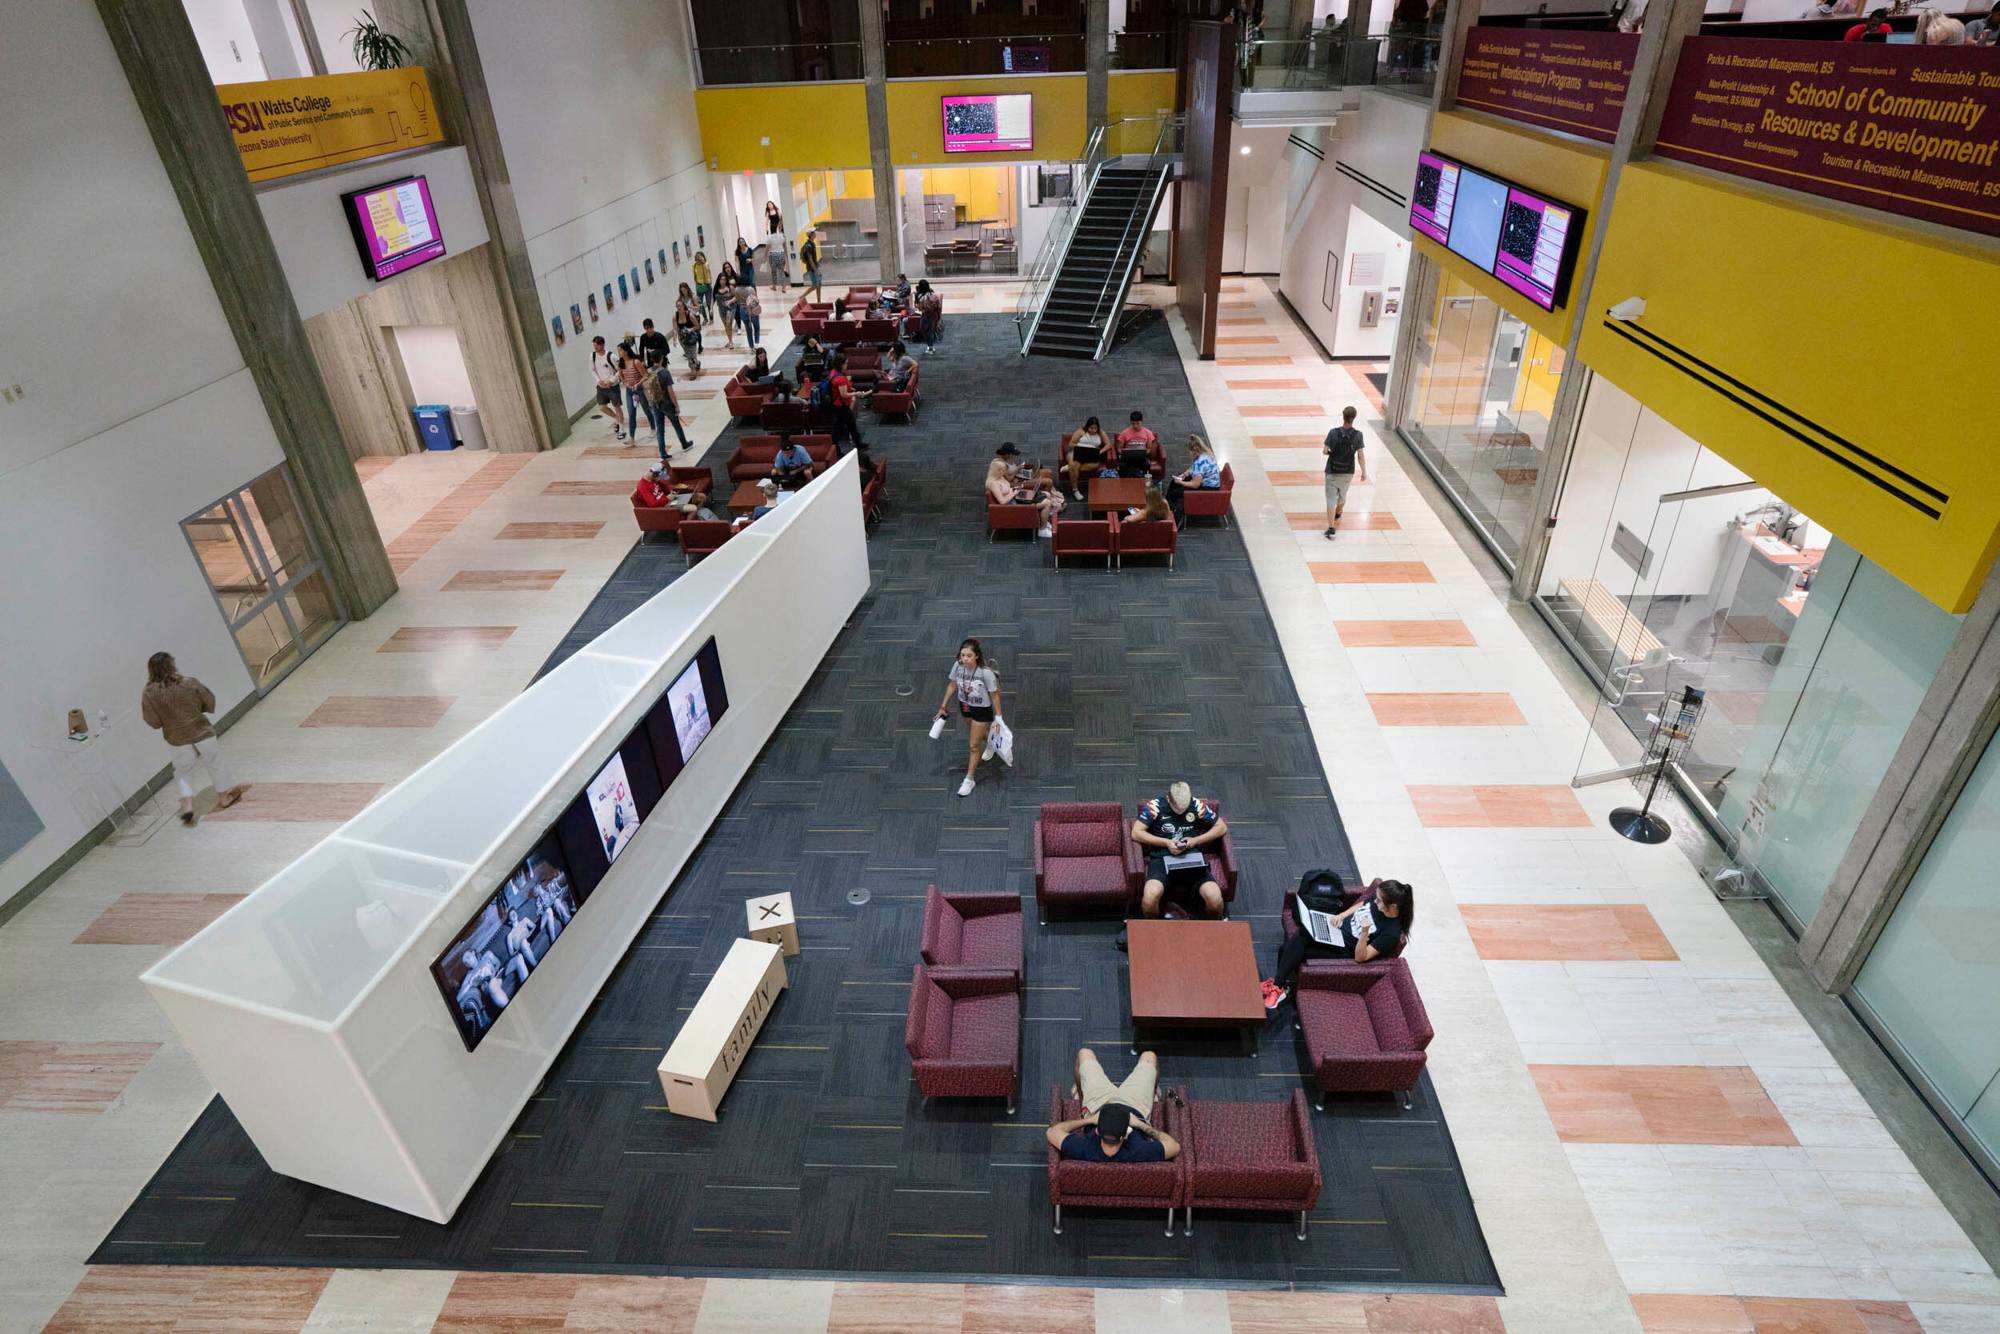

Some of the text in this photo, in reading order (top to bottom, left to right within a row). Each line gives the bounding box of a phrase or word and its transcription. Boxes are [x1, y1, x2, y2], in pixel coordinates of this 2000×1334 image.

[1707, 53, 1836, 75] Parks & Recreation Management, BS
[1500, 64, 1582, 91] Interdisciplinary Programs
[1708, 78, 1776, 97] Non-Profit Leadership &
[1910, 67, 1976, 86] Sustainable
[259, 95, 332, 116] Watts College
[1786, 80, 1987, 131] School of Community
[268, 107, 375, 130] of Public Service and Community Solutions
[1690, 113, 1756, 134] Recreation Therapy, BS
[237, 133, 313, 153] rizona State University
[1742, 138, 1799, 159] Social Entrepreneurship
[1760, 108, 1999, 167] Resources & Development
[1822, 152, 2000, 198] Tourism & Recreation Management, BS
[720, 981, 771, 1073] family
